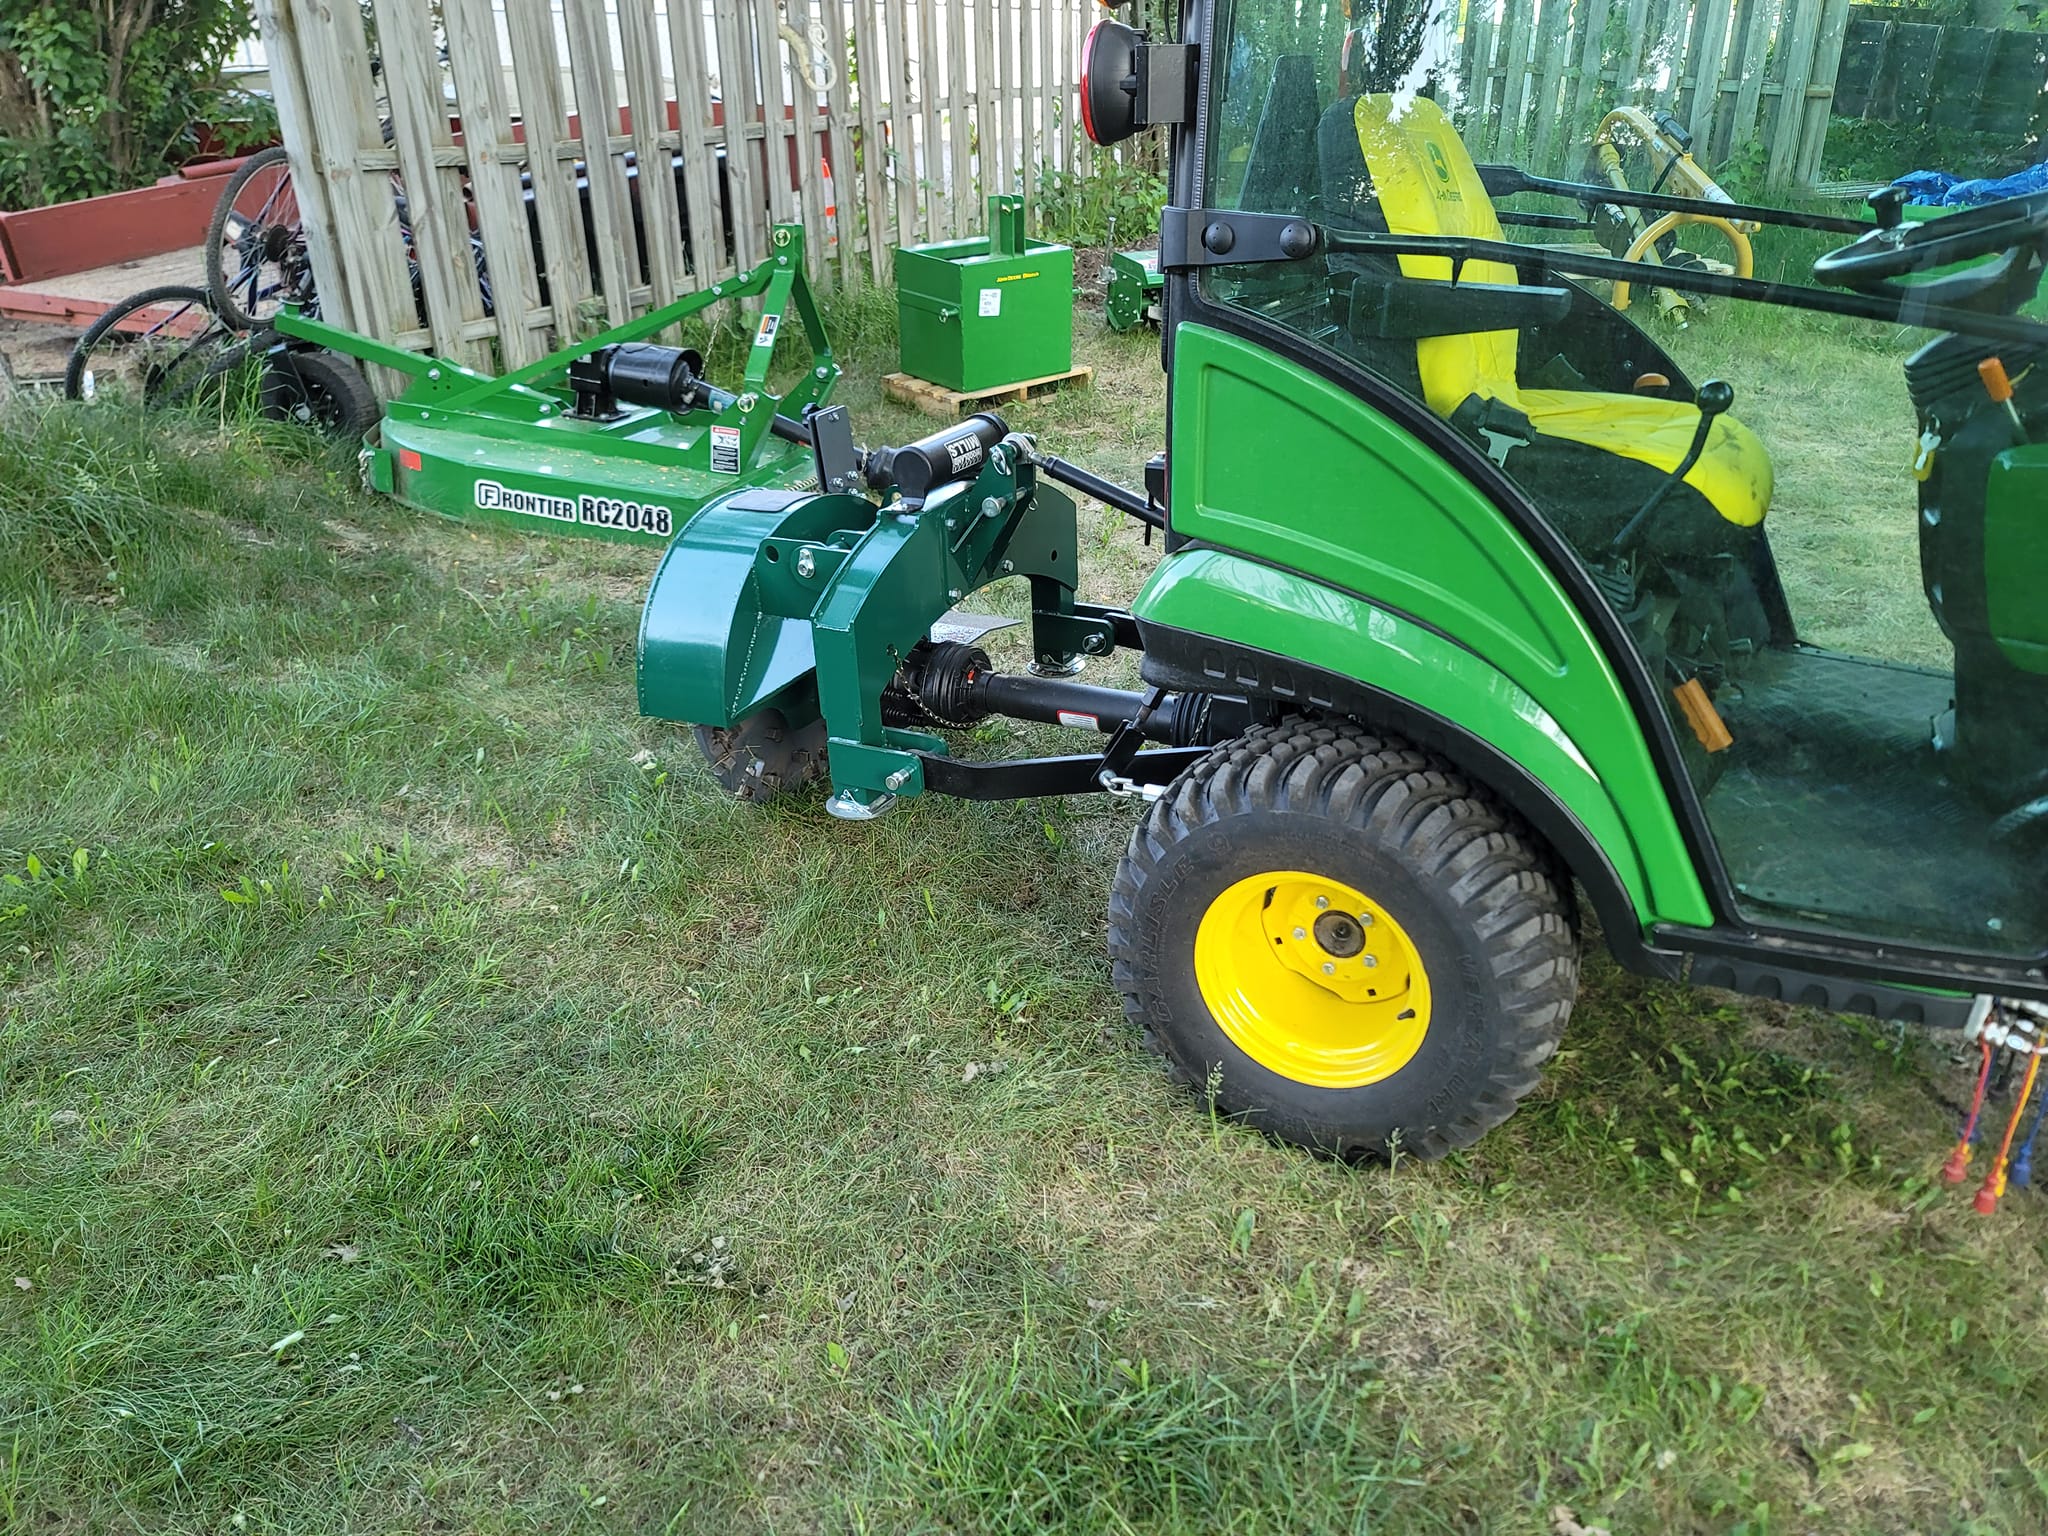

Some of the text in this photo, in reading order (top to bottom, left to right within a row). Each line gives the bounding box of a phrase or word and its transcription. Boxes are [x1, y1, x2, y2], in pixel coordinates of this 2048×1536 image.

[947, 434, 980, 458] MILLS
[478, 483, 670, 534] FRONTIER RC2048
[1143, 853, 1195, 1023] CARLISLE
